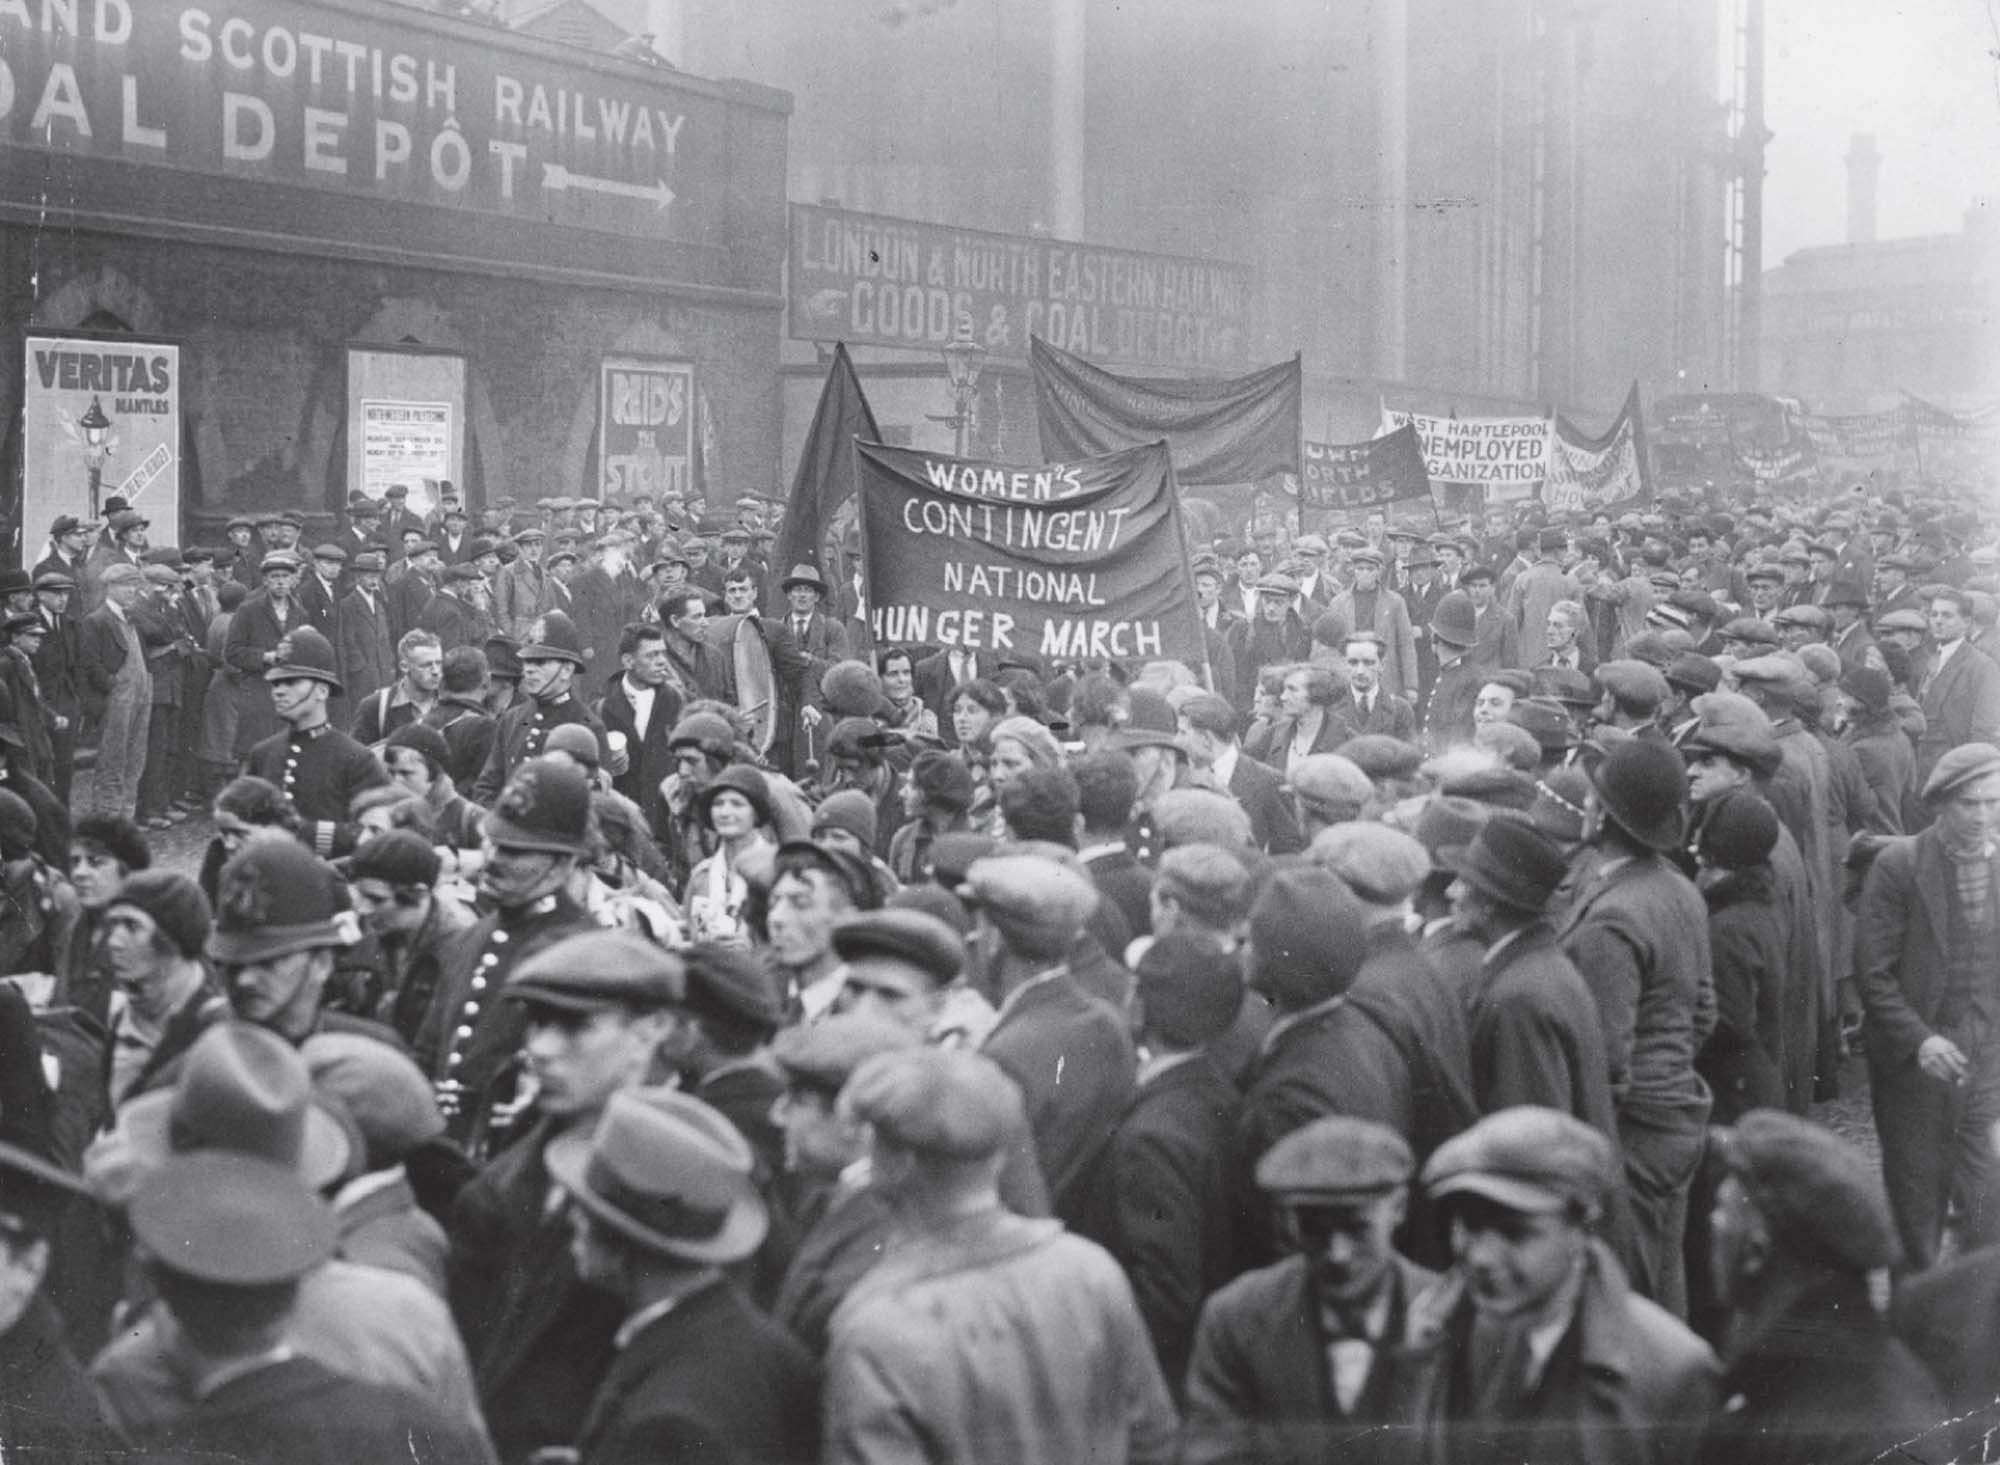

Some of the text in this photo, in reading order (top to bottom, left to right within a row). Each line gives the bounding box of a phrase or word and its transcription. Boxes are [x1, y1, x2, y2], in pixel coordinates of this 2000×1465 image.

[0, 0, 685, 153] AND SCOTTISH RAILWAY
[0, 58, 527, 198] AL DEPÔT
[802, 211, 919, 282] LONDON
[927, 247, 946, 287] &
[953, 235, 1039, 298] NORTH
[1048, 249, 1156, 308] EASTERN
[852, 281, 974, 342] GOODS
[985, 303, 1010, 347] &
[1026, 300, 1109, 355] COAL
[35, 350, 170, 395] VERITAS
[1421, 435, 1543, 462] NEMPLOYED
[1448, 422, 1548, 438] HARTLEPOOL
[925, 460, 1083, 501] WOMEN'S
[1306, 464, 1371, 482] ORTH
[1426, 459, 1546, 481] GANIZATION
[1309, 480, 1396, 505] IELDS
[904, 498, 1130, 551] CONTINGENT
[944, 563, 1106, 605] NATIONAL
[872, 605, 1162, 658] HUNGER MARCH
